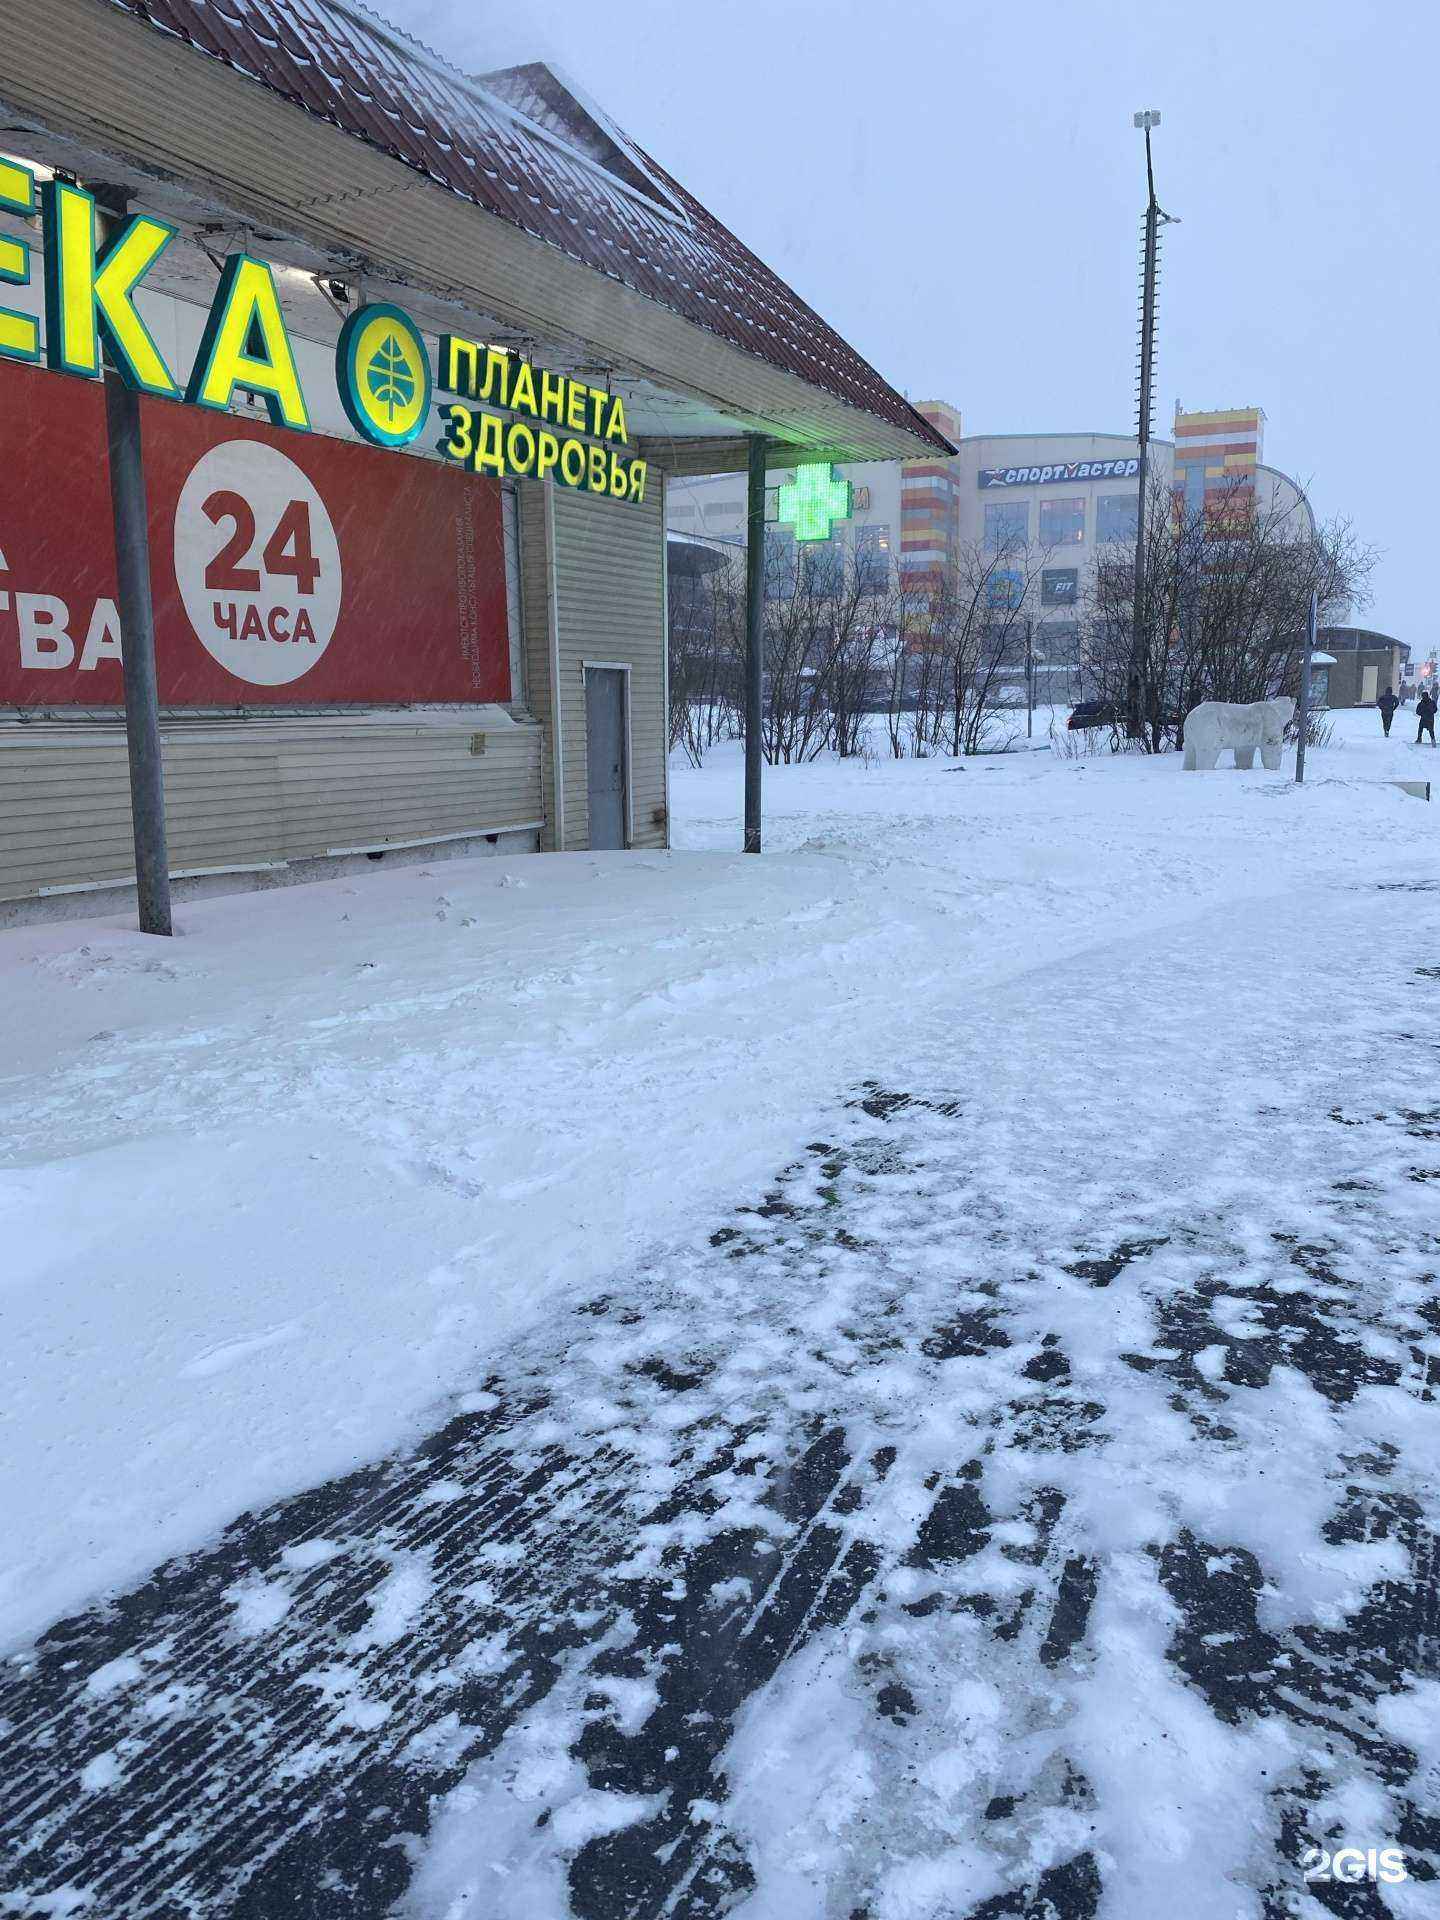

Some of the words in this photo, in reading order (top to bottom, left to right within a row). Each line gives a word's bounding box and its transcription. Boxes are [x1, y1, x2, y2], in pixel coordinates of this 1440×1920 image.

[445, 335, 628, 444] ПЛАНЕТА
[445, 404, 647, 502] ЗДОРОВЬЯ
[201, 490, 320, 594] 24
[213, 602, 316, 643] ЧАСА
